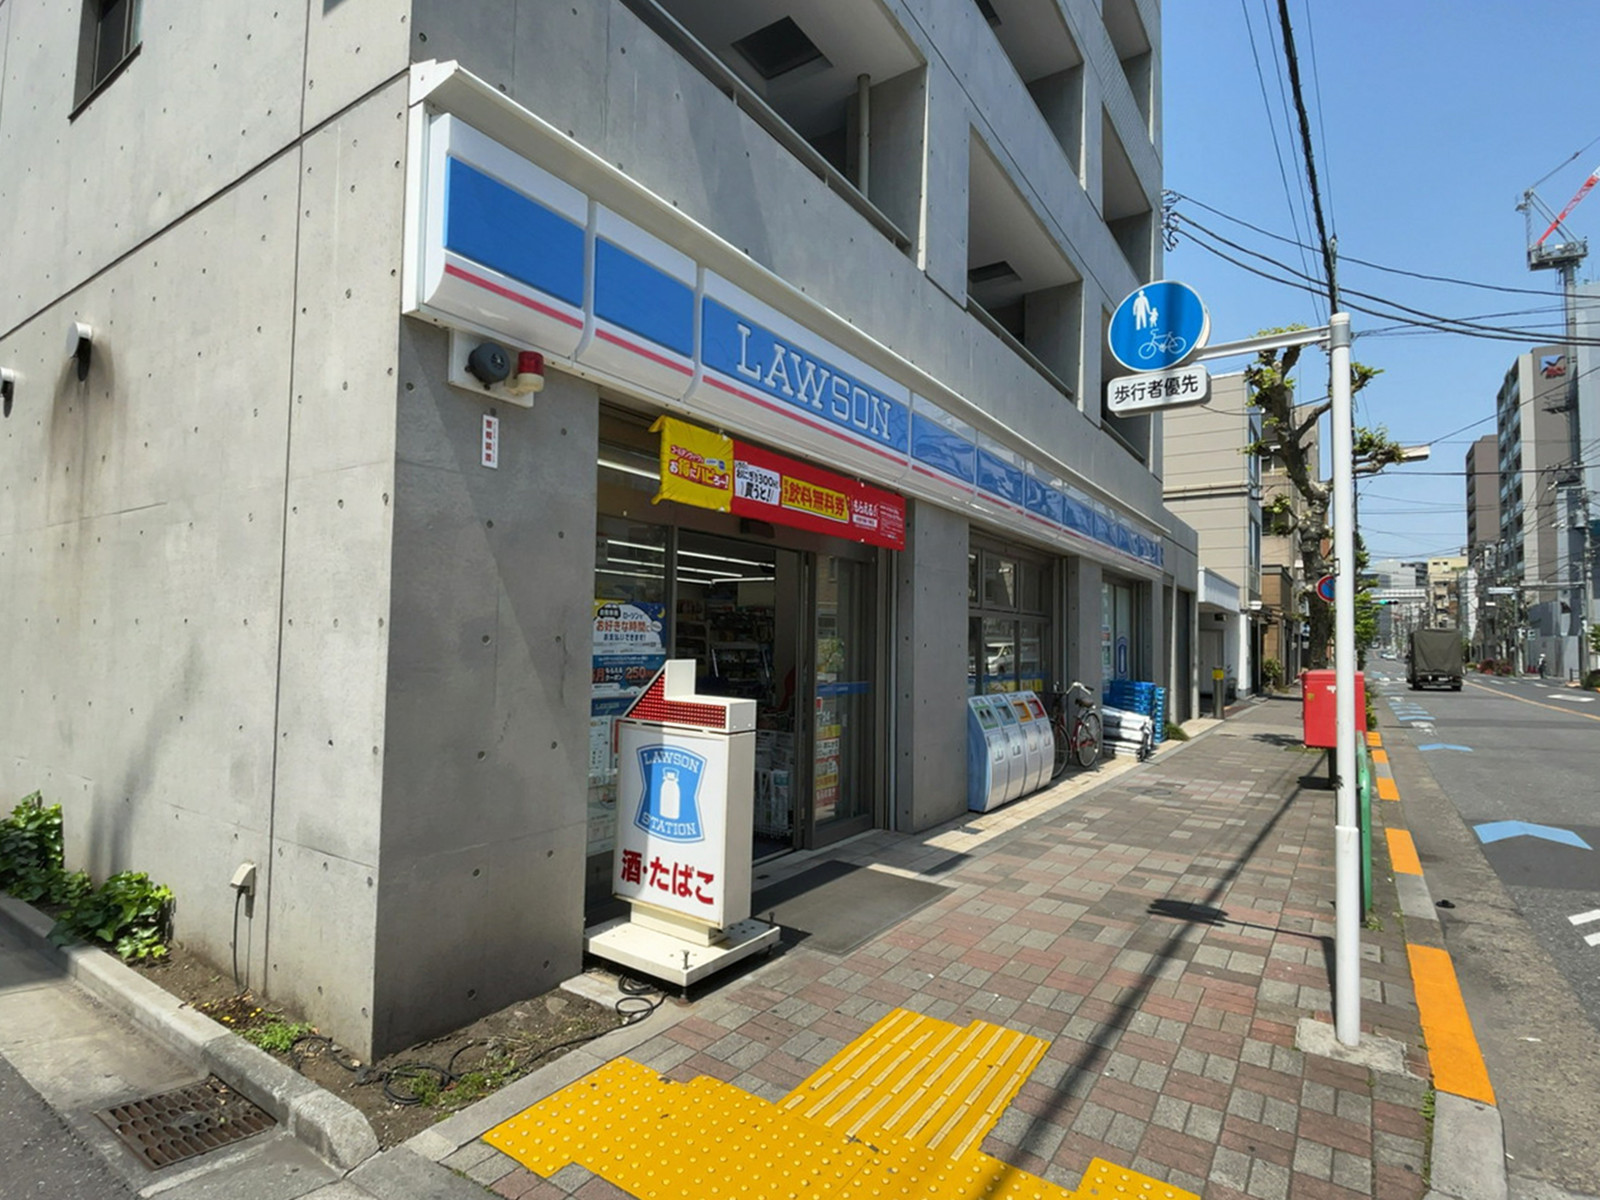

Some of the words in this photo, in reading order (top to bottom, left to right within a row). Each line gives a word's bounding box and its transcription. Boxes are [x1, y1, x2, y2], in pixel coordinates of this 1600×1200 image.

[737, 322, 891, 440] LAWSON
[1114, 375, 1199, 405] 歩行者優先
[643, 752, 700, 774] LAWSON
[642, 812, 697, 836] STATION
